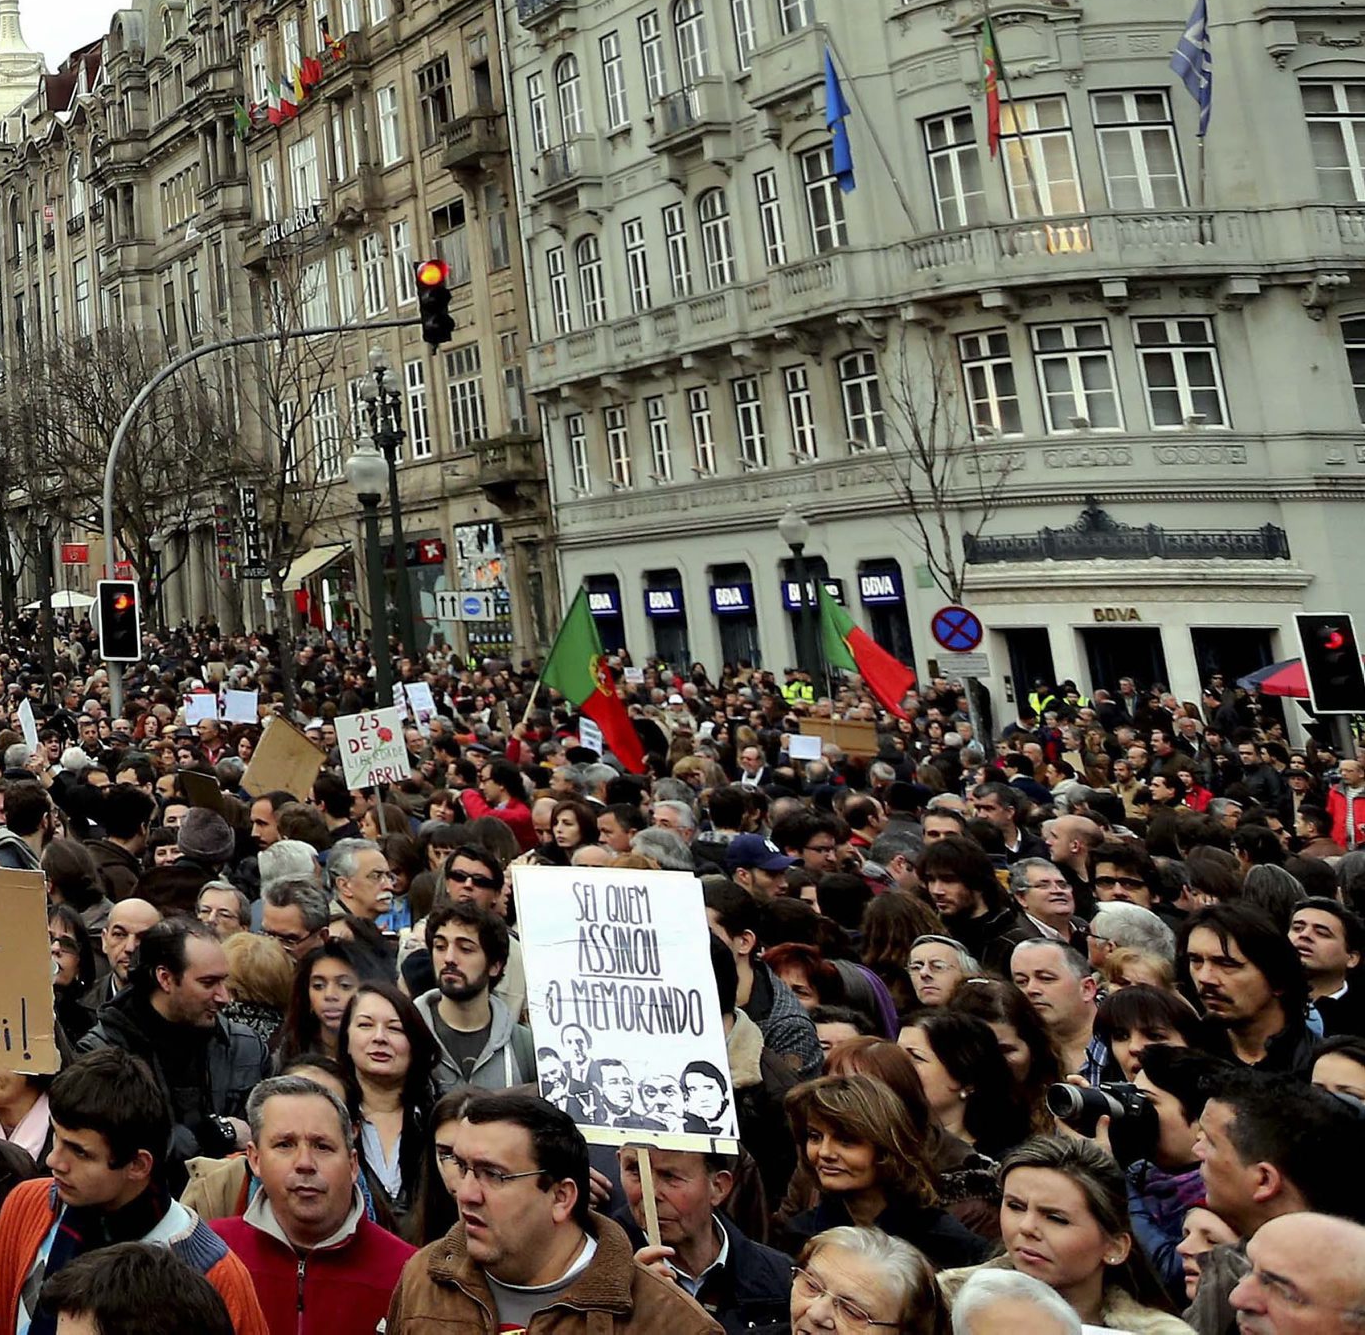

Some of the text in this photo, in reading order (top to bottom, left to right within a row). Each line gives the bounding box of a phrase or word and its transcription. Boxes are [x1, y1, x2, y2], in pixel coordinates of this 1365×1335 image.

[715, 586, 743, 606] BBVA
[861, 576, 895, 596] BBVA
[649, 591, 674, 609] BBVA
[1093, 607, 1142, 622] BBVA
[355, 713, 380, 732] 25
[348, 736, 372, 754] DE
[367, 764, 408, 786] ABRIL
[572, 881, 652, 925] SEI QUEM
[577, 923, 662, 977] ASSINOU
[546, 978, 705, 1037] O MEMORANDO
